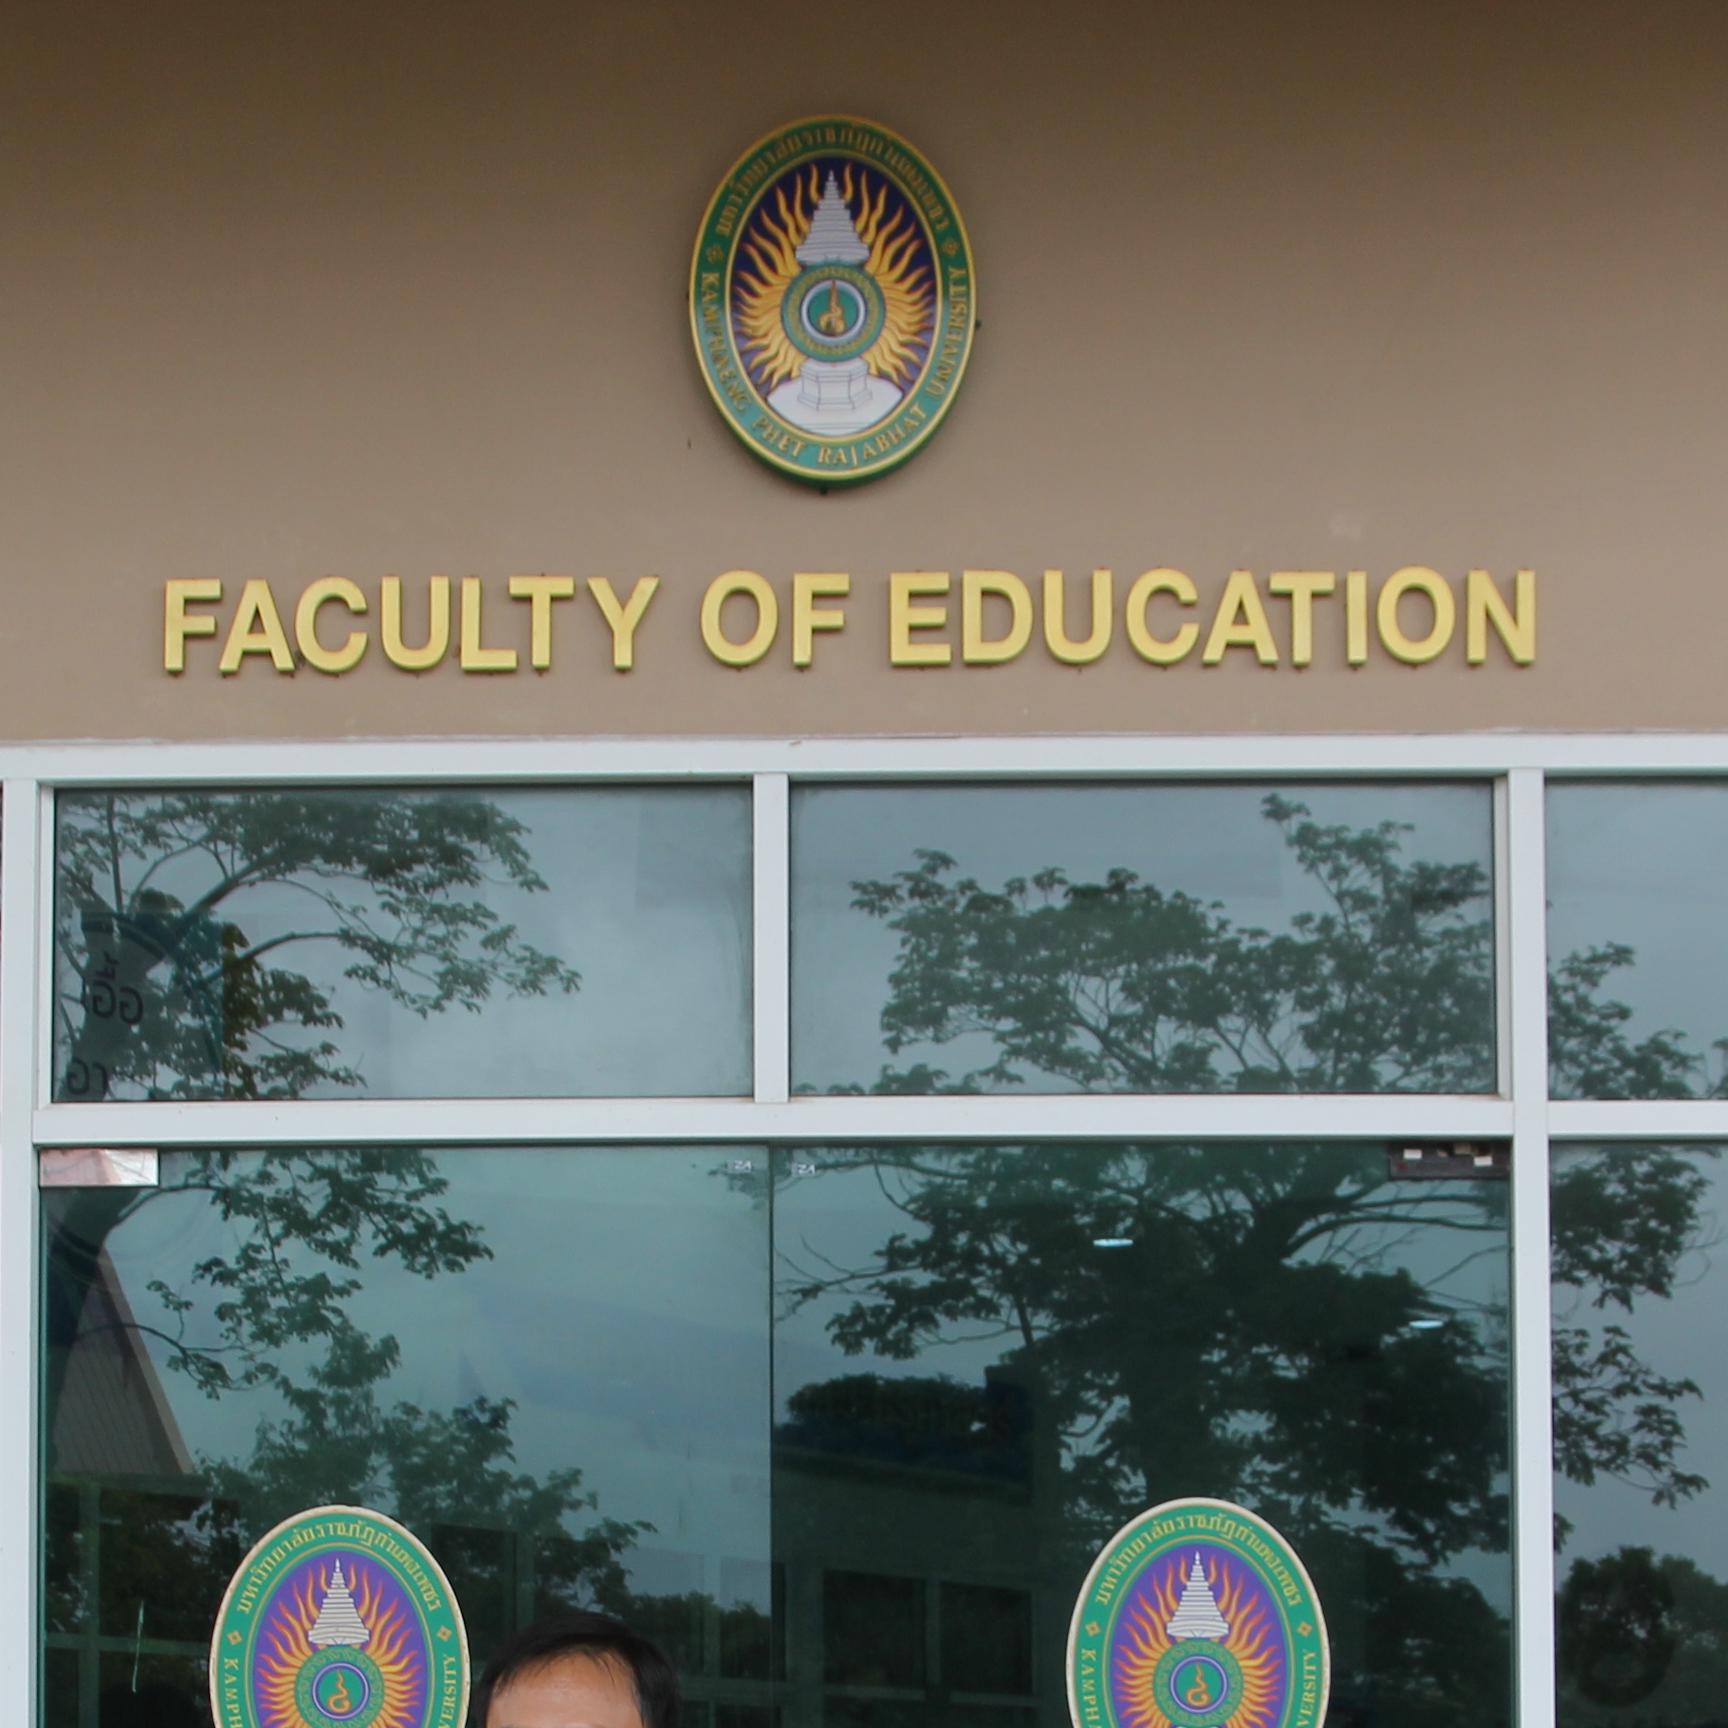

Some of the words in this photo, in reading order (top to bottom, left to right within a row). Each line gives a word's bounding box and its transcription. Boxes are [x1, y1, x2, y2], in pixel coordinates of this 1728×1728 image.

[752, 415, 808, 458] PHET
[818, 402, 927, 468] RAJABHAT
[925, 265, 968, 397] UNIVERSITY
[163, 576, 659, 674] FACULTY
[698, 570, 850, 668] OF
[888, 566, 1537, 667] EDUCATION
